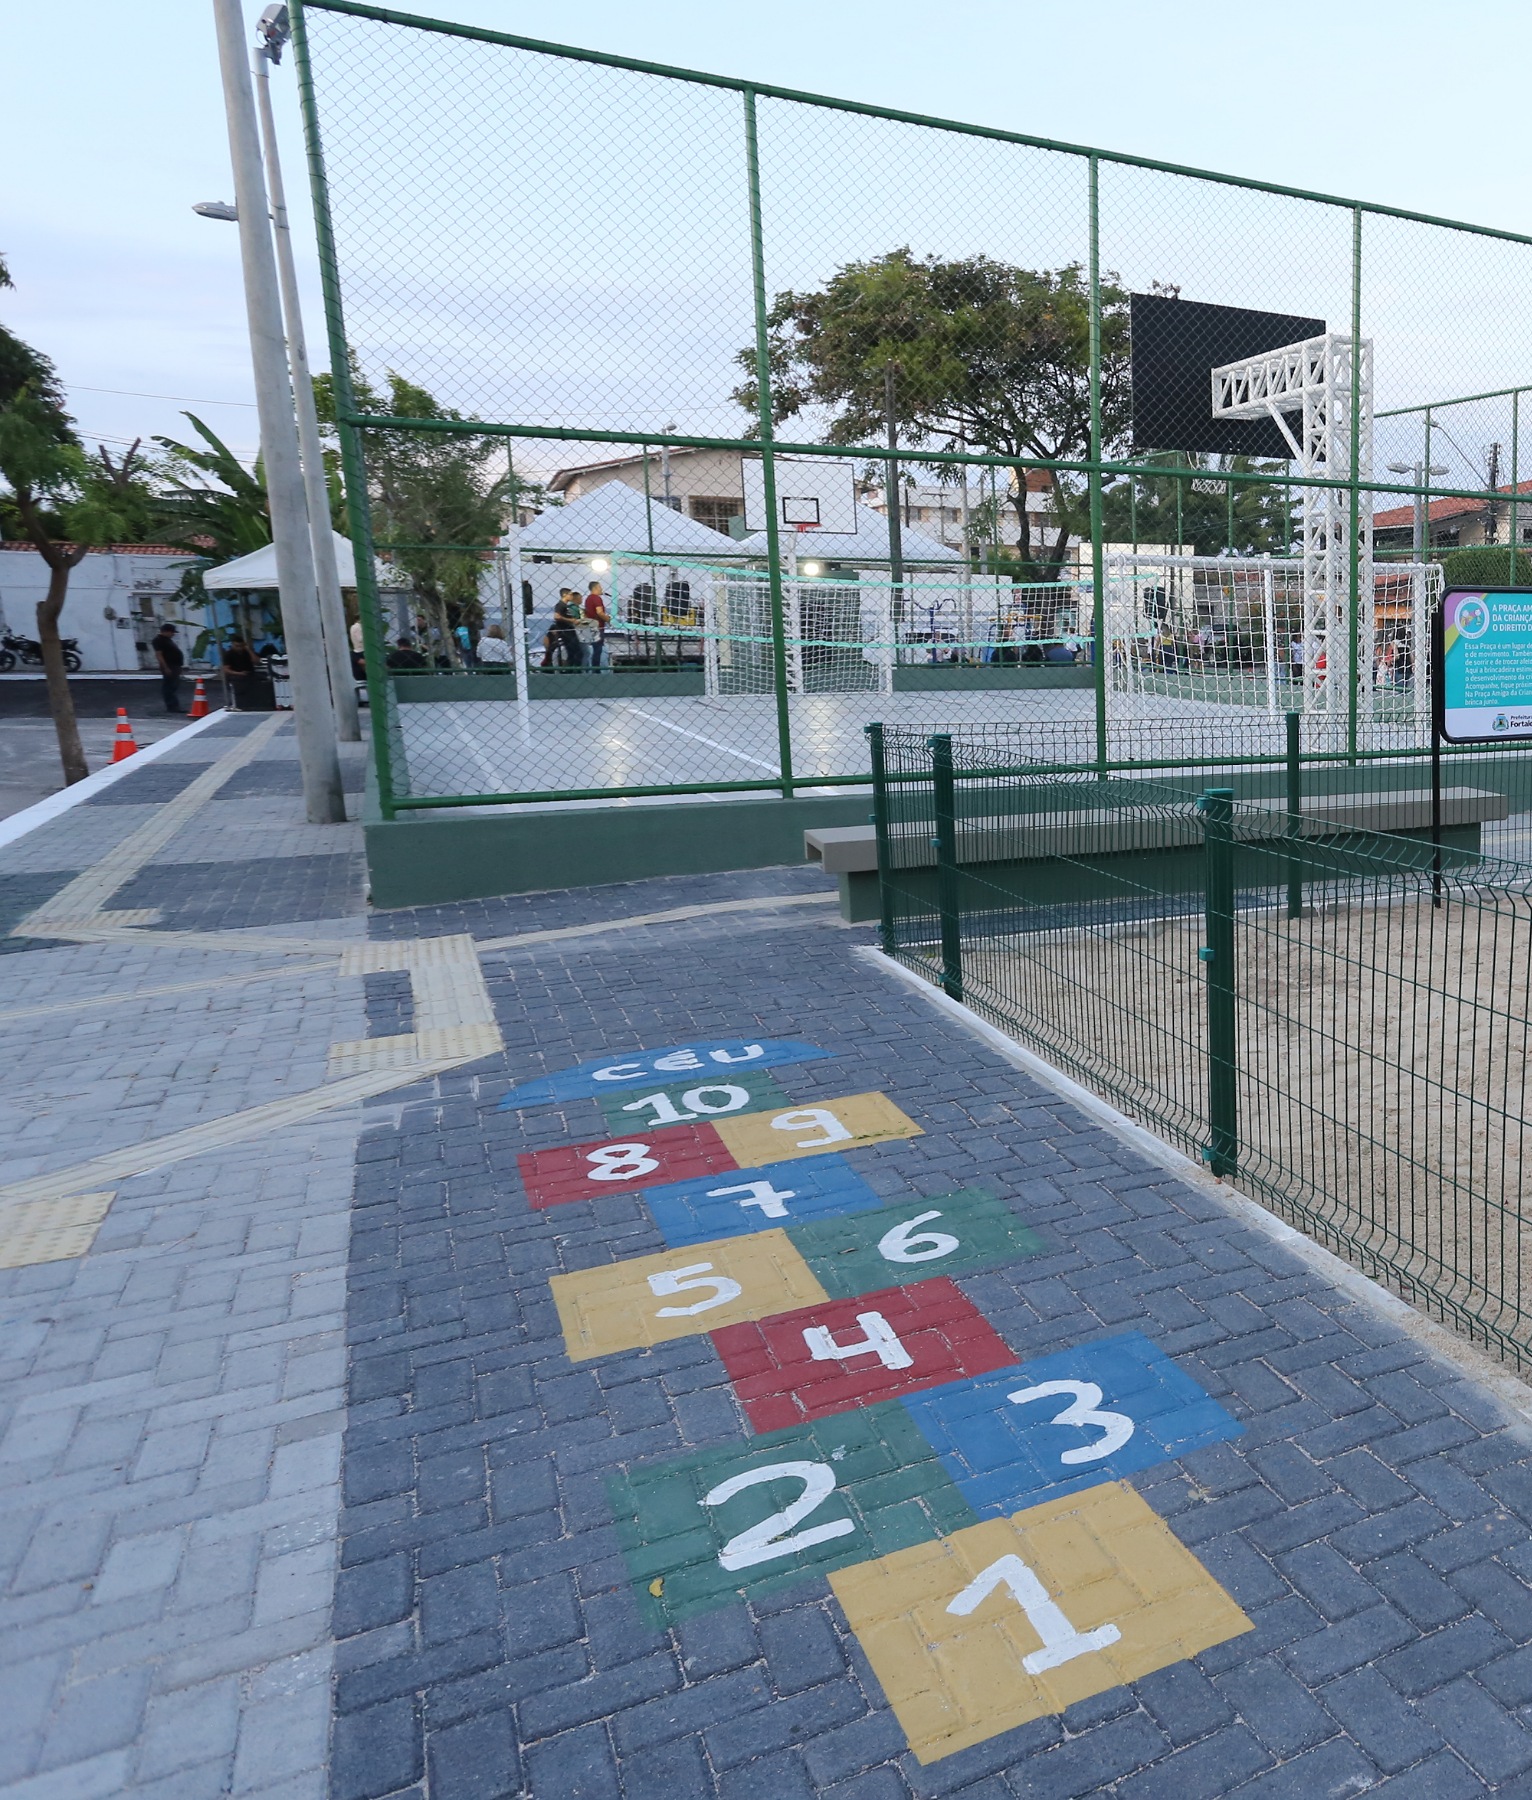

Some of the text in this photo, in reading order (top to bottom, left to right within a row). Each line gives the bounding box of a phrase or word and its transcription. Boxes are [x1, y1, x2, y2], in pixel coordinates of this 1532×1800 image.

[1492, 614, 1502, 622] DA
[1504, 614, 1532, 623] CRIANÇA
[1492, 623, 1499, 632] O
[1500, 623, 1527, 632] DIREITO
[1499, 604, 1521, 613] PRAÇA
[1464, 642, 1479, 650] Essa
[1480, 642, 1497, 650] Praça
[1511, 642, 1526, 651] lugar
[1473, 658, 1489, 666] sorrir
[1465, 666, 1479, 674] Aqui
[1500, 682, 1515, 690] fique
[1474, 690, 1491, 698] Praça
[1492, 690, 1510, 698] Amiga
[621, 1084, 750, 1126] 10
[770, 1108, 854, 1149] 9
[586, 1142, 659, 1182] 8
[705, 1180, 797, 1219] 7
[877, 1210, 960, 1264] 6
[646, 1262, 742, 1318] 5
[801, 1310, 915, 1370] 4
[1007, 1379, 1135, 1465] 3
[696, 1460, 856, 1572] 2
[945, 1553, 1122, 1676] 1
